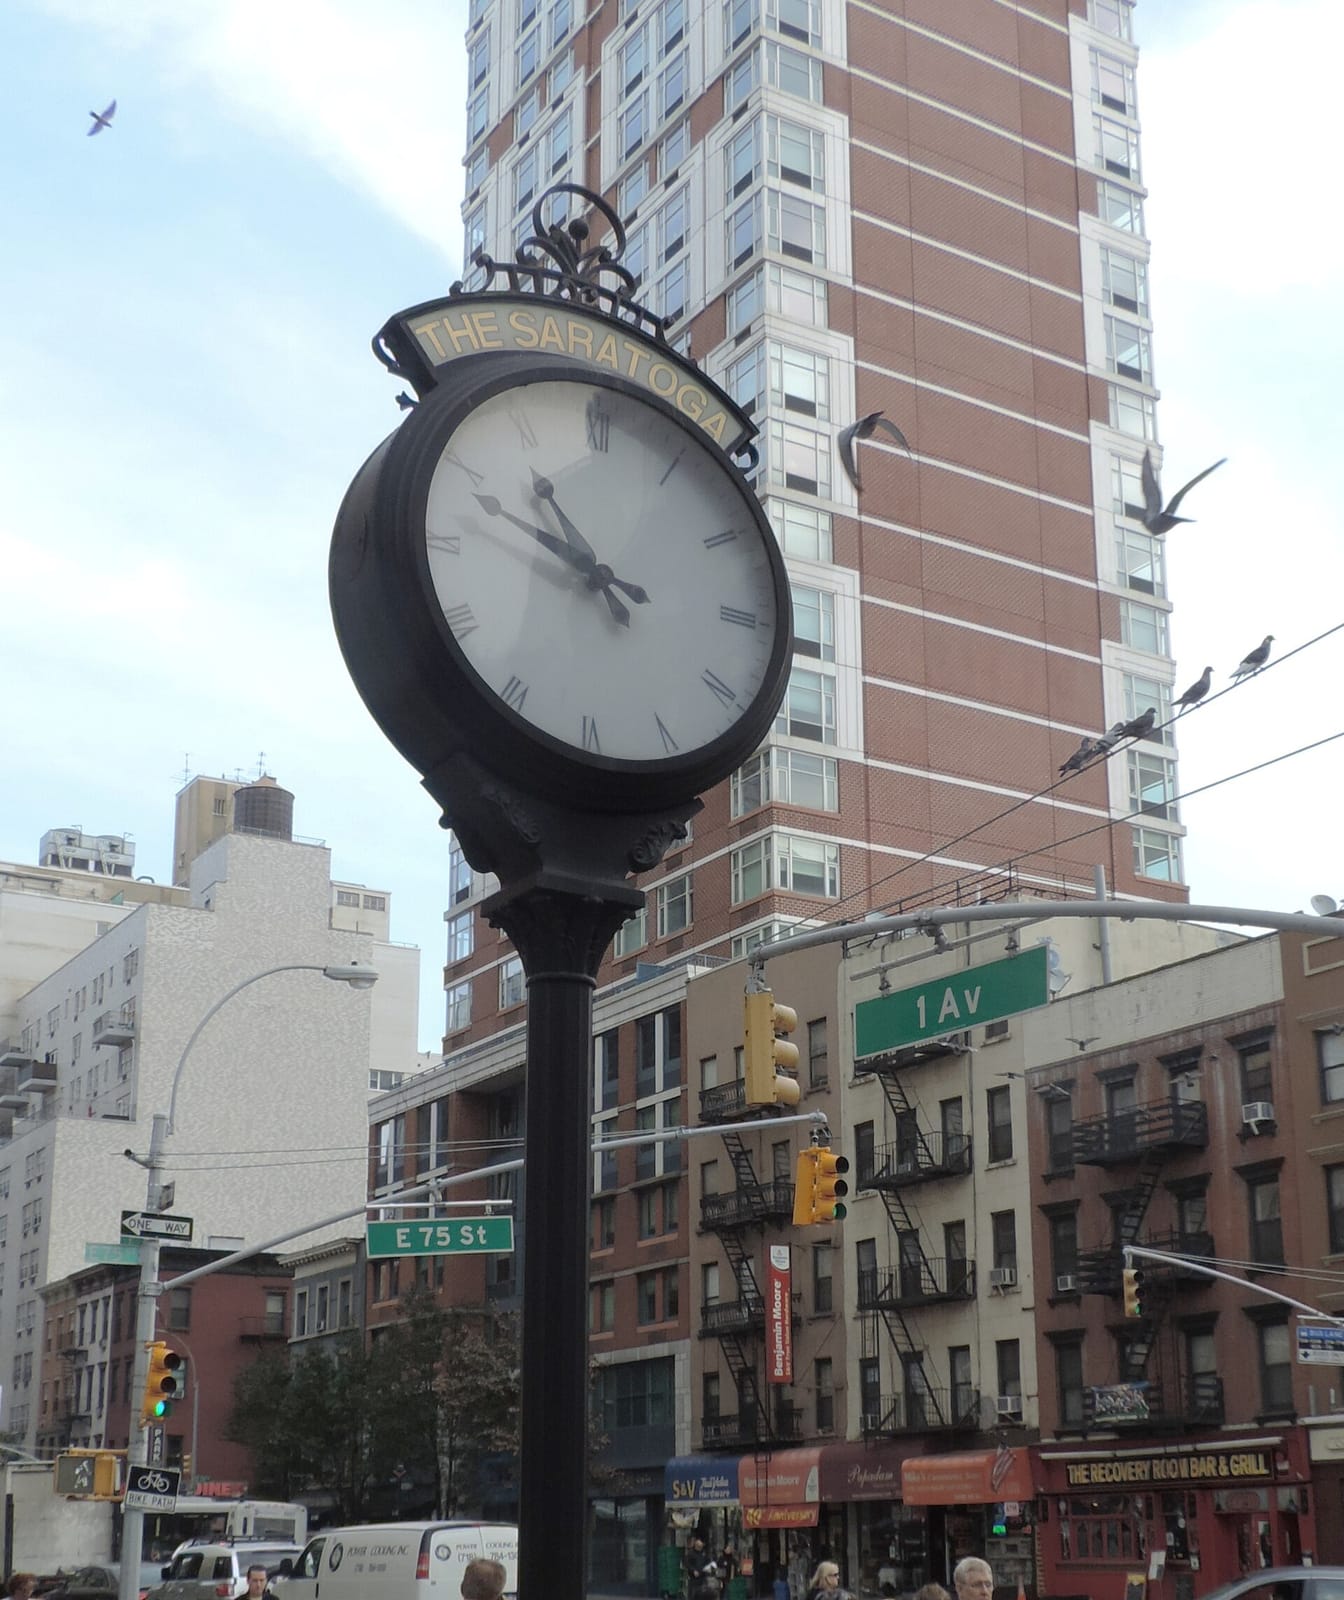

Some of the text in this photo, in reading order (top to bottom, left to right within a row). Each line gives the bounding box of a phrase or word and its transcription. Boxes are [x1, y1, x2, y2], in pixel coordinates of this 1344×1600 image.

[415, 310, 727, 444] THE SARATOGA
[703, 530, 737, 550] II
[444, 603, 480, 641] VIII
[720, 605, 757, 630] III
[500, 676, 529, 713] VII
[701, 668, 737, 710] IV
[582, 715, 601, 752] VI
[654, 712, 680, 753] V
[916, 995, 926, 1029] 1
[128, 1219, 187, 1233] ONE WAY
[396, 1225, 487, 1248] E 75 St
[773, 1280, 783, 1377] Benjamin Moore
[776, 1475, 800, 1486] Moore
[1067, 1453, 1269, 1484] THE RECOVERY ROOM BAR & GRILL
[128, 1493, 173, 1509] BIKE PATH
[672, 1479, 696, 1499] S&V
[699, 1489, 730, 1499] Hardware
[768, 1508, 817, 1523] Anniversary
